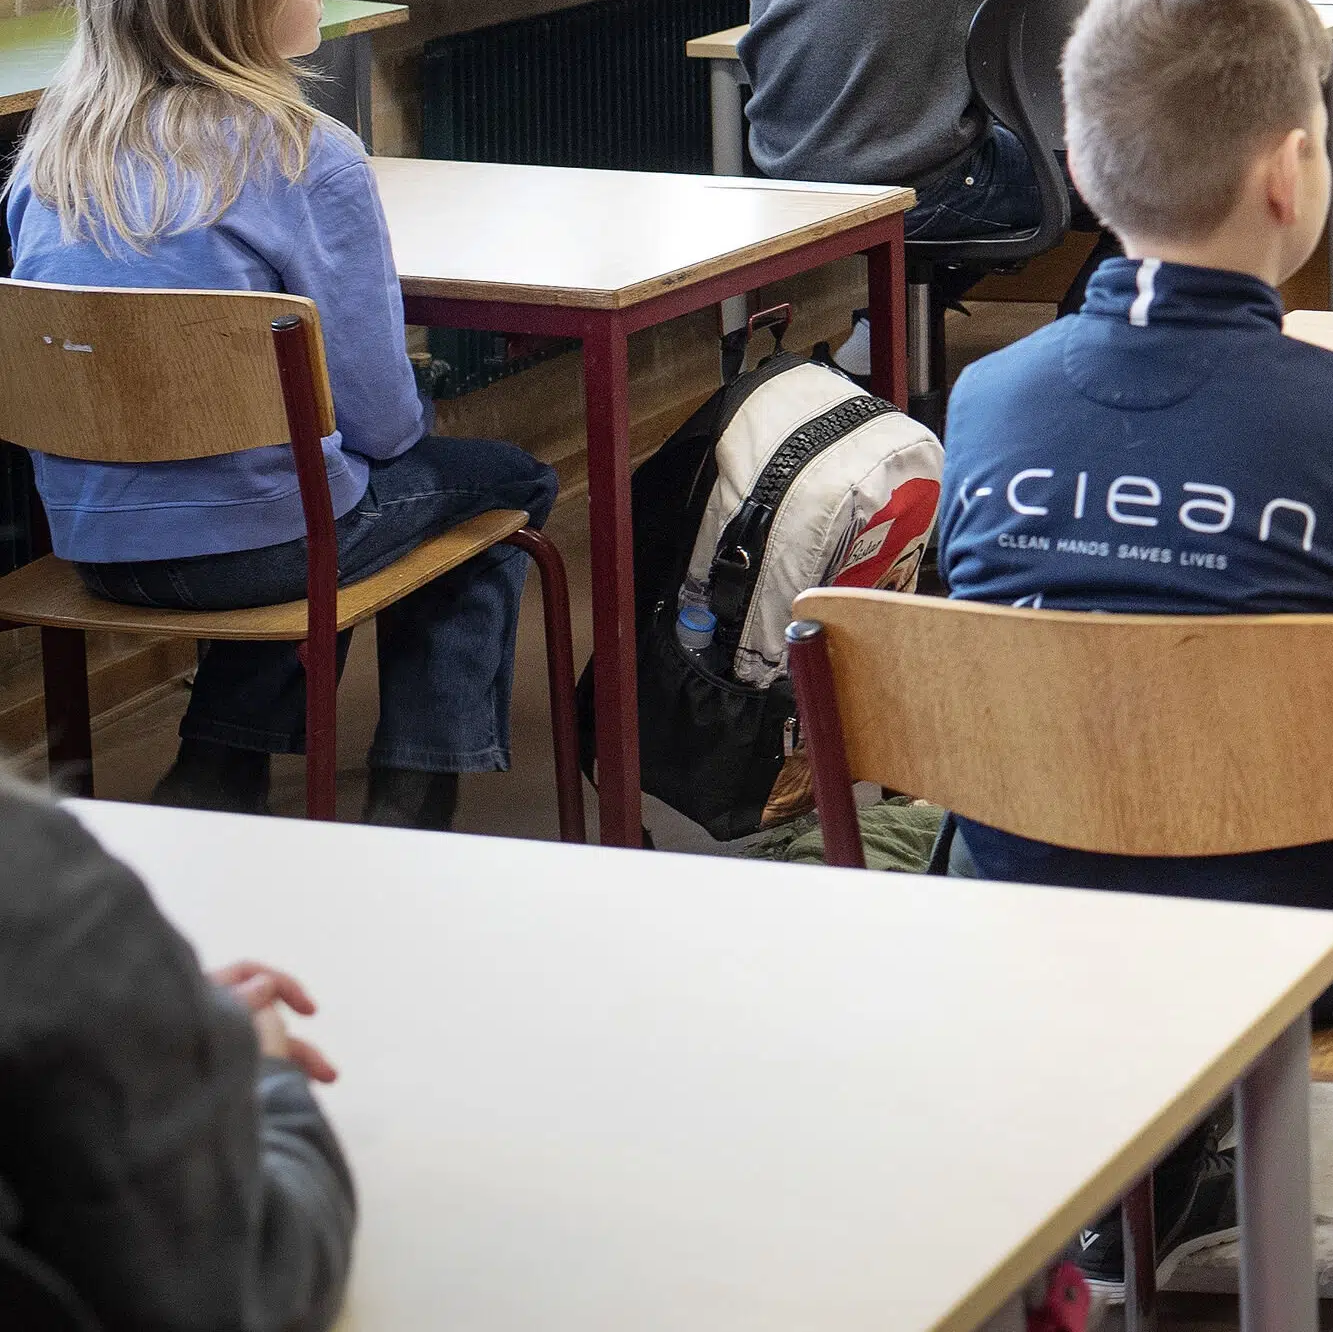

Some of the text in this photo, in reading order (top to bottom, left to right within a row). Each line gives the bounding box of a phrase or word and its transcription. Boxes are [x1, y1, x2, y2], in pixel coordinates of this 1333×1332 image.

[998, 533, 1228, 570] CLEAN HANDS SAVES LIVES
